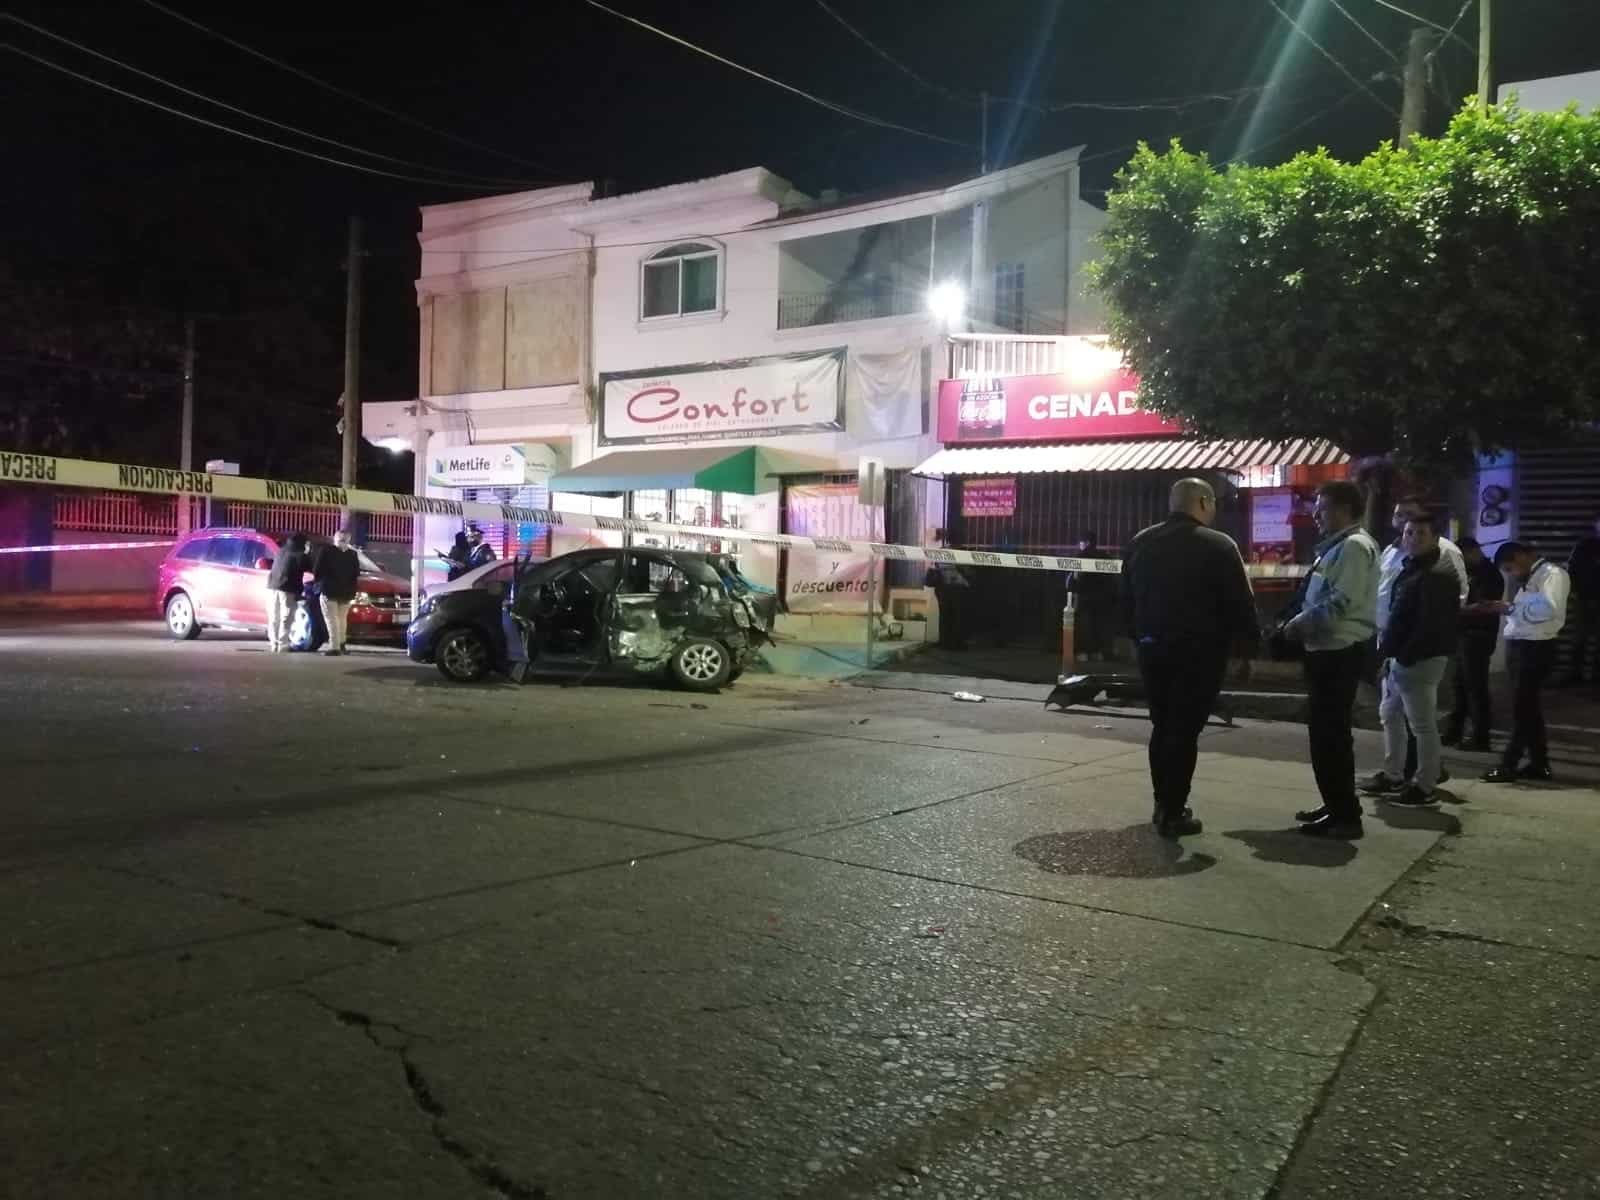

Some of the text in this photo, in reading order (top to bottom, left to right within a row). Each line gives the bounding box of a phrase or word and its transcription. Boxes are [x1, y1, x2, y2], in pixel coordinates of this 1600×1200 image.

[627, 382, 810, 423] Confort
[1028, 391, 1137, 420] CENAD
[0, 453, 57, 481] PRECA
[449, 457, 491, 471] MetLife
[119, 465, 213, 493] PRECAUCION
[266, 481, 348, 506] PRECAUCION
[392, 495, 464, 516] PRECAUCION
